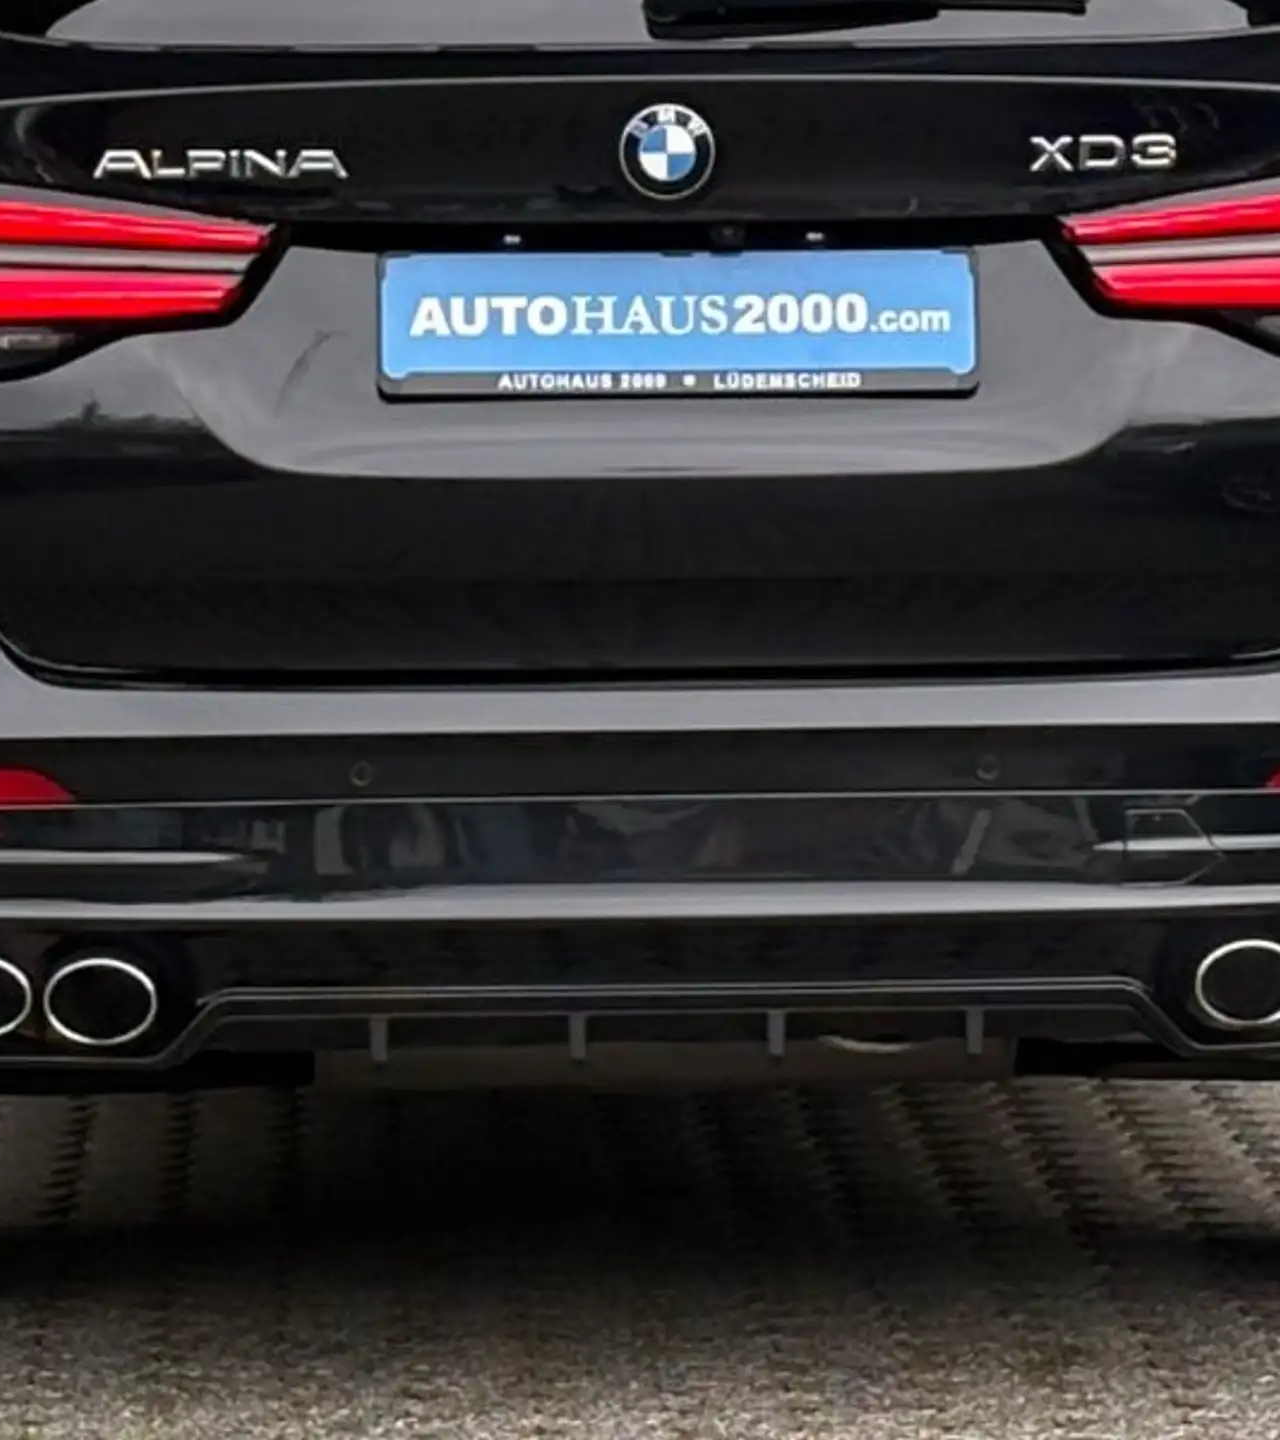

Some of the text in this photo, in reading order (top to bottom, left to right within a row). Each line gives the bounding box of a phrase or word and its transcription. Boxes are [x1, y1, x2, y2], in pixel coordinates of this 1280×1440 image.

[93, 148, 348, 180] ALPINA
[1029, 132, 1178, 172] XD3
[409, 293, 952, 337] AUTOHAUS2000.com
[497, 372, 612, 390] AUTOHAUS
[714, 370, 862, 390] LÜDENSCHEID
